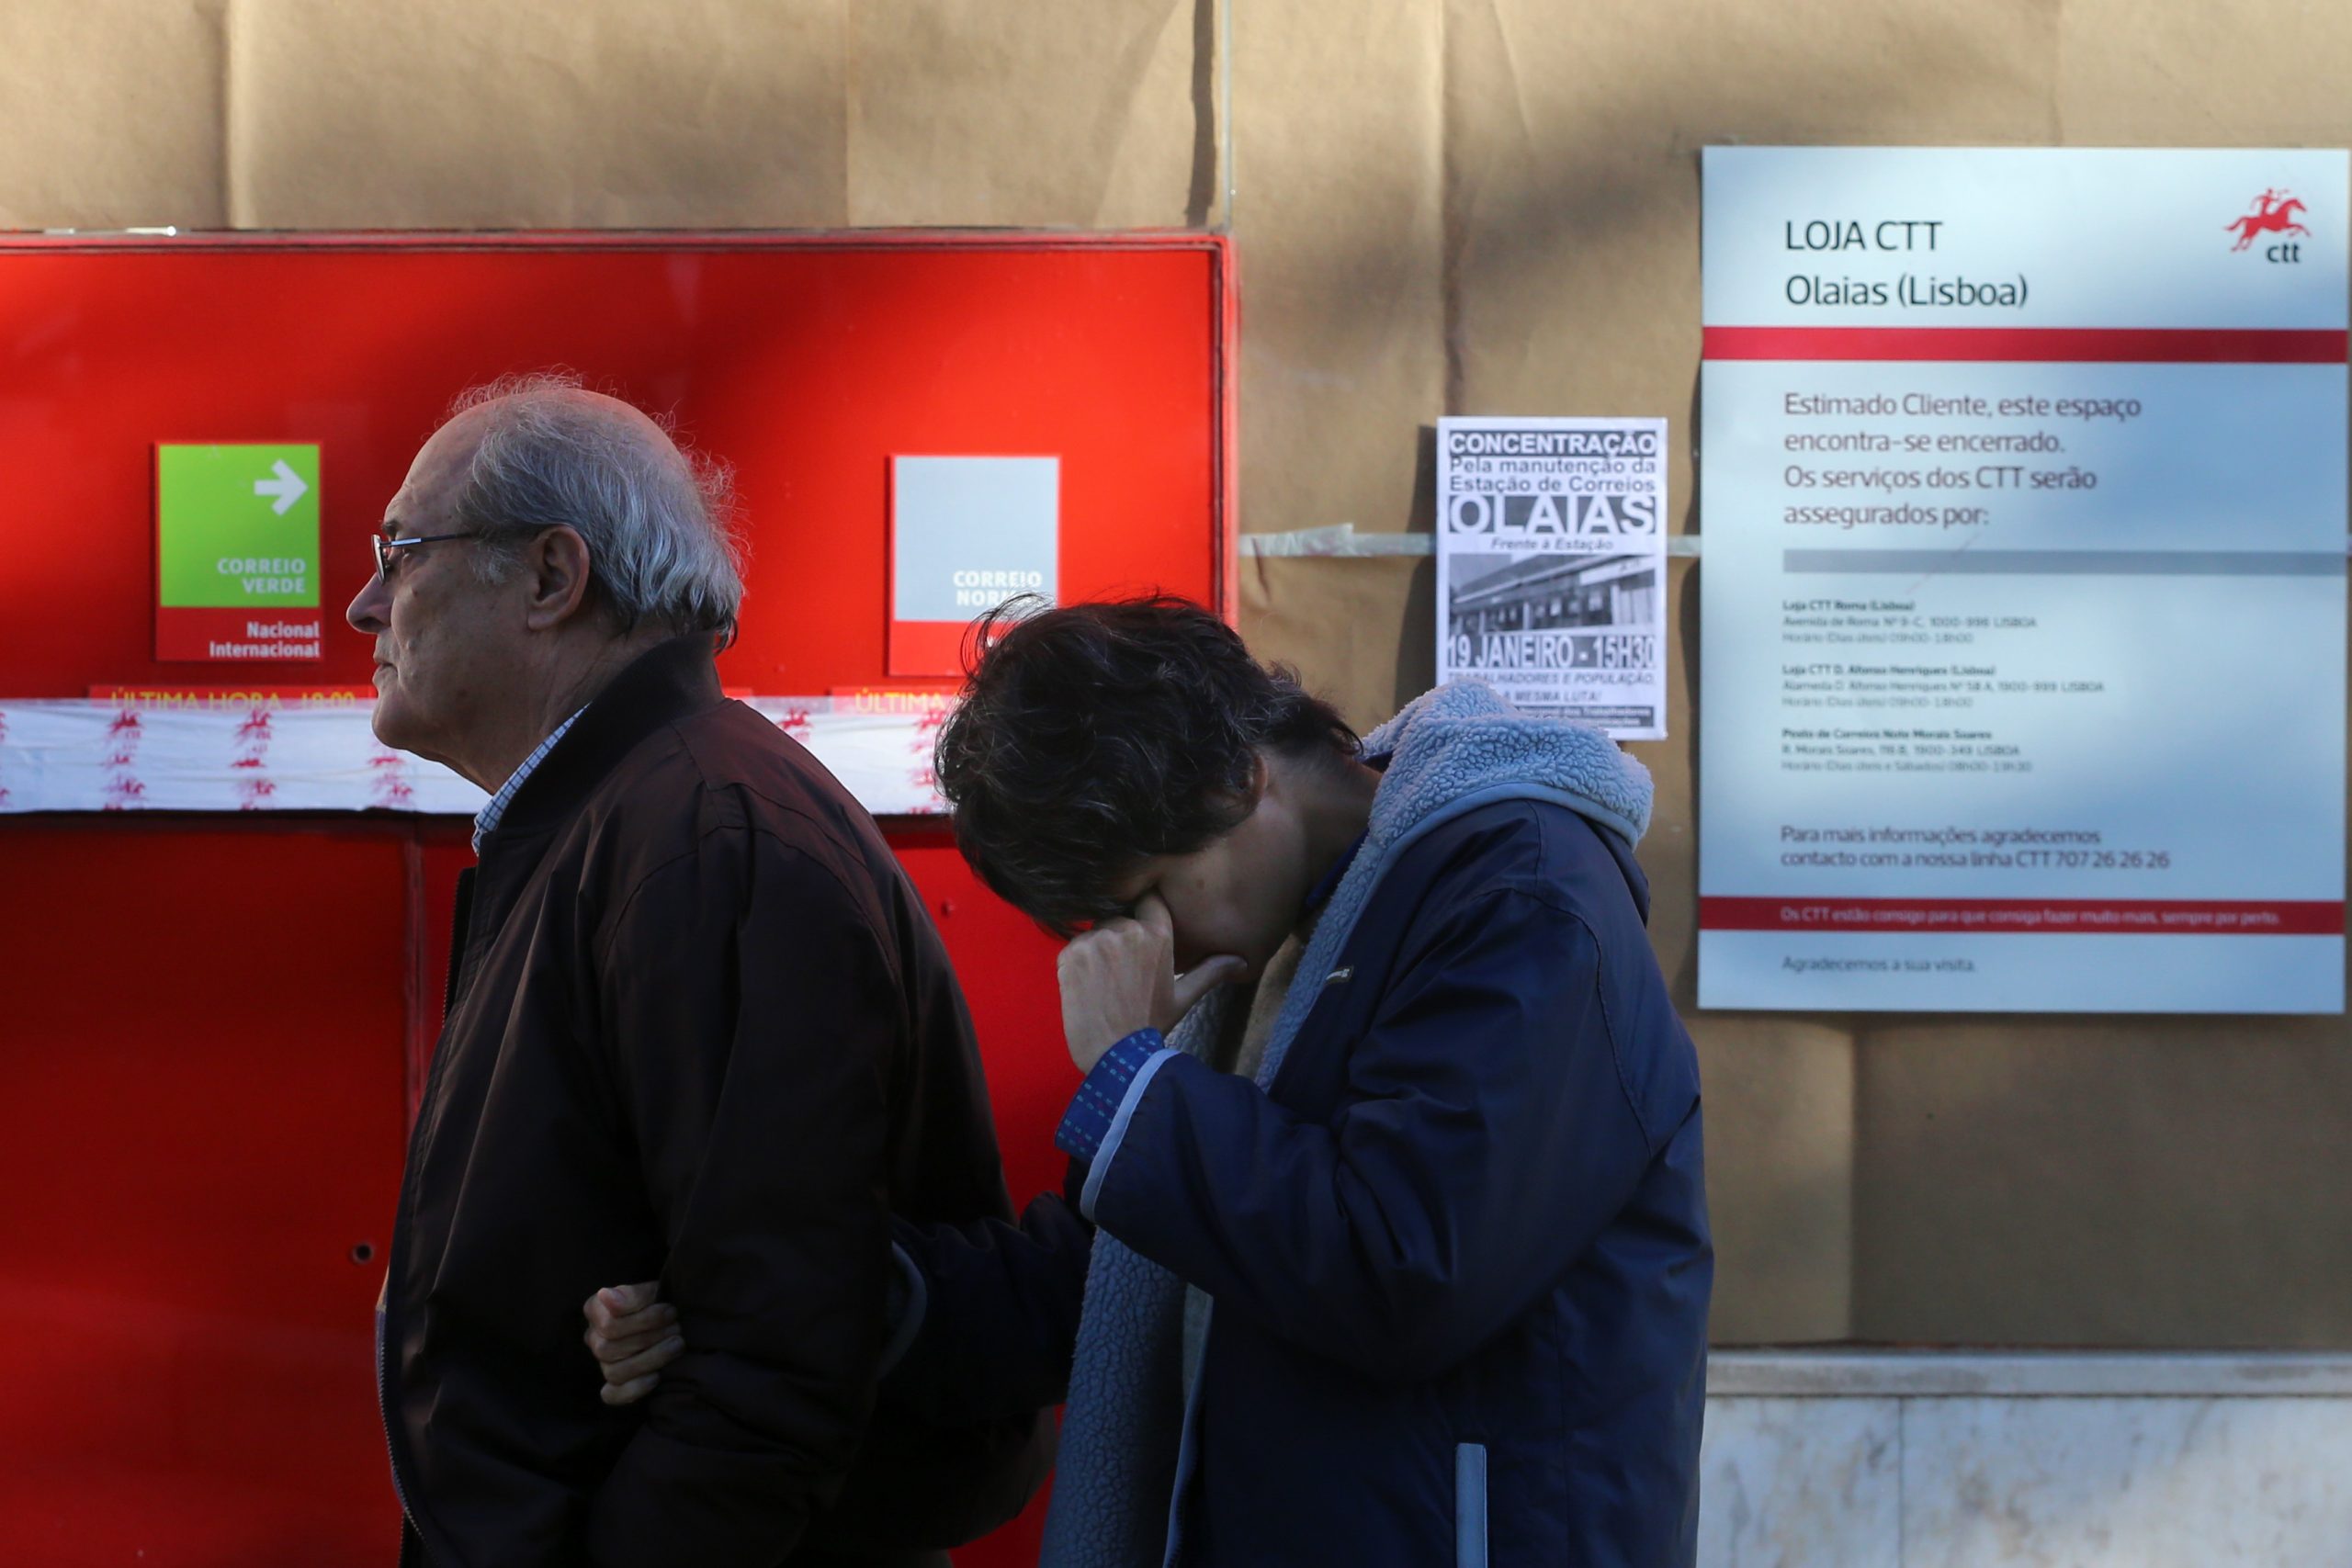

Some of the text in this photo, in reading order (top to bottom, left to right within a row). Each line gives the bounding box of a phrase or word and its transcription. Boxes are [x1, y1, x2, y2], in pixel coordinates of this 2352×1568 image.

[1786, 220, 1943, 251] LOJA CTT
[2266, 243, 2300, 264] ctt
[1786, 273, 2028, 308] Olaias (Lisboa)
[1784, 392, 2142, 423] Estimado Cliente, este espaço
[1449, 430, 1657, 457] CONCENTRAÇÃO
[1784, 431, 2065, 453] encontra-se encerrado.
[1450, 457, 1656, 477] Pela manutenção da
[1450, 476, 1656, 493] Estação de Correios
[1784, 466, 2097, 492] Os serviços dos CTT serão
[1450, 494, 1656, 534] OLAIAS
[1784, 504, 1991, 529] assegurados por:
[1491, 536, 1537, 549] Frente
[1555, 536, 1614, 552] Estação
[217, 558, 306, 574] CORREIO
[242, 578, 306, 593] VERDE
[953, 570, 1043, 588] CORREIO
[1809, 600, 1832, 612] CTT
[246, 621, 320, 638] Nacional
[209, 640, 320, 658] Internacional
[1447, 635, 1471, 669] 19
[1476, 635, 1574, 669] JANEIRO
[1593, 635, 1656, 669] 15H30
[1808, 664, 1832, 676] CTT
[855, 688, 945, 713] ÚLTIMA
[1781, 826, 2101, 847] Para mais informações agradecemos
[1781, 850, 2171, 868] contacto com a nossa linha CTT 707 26 26 26
[1781, 907, 1800, 922] Os
[1802, 907, 1830, 921] CTT
[1782, 956, 1887, 974] Agradecemos
[1891, 961, 1901, 972] a
[1904, 961, 1932, 972] sua
